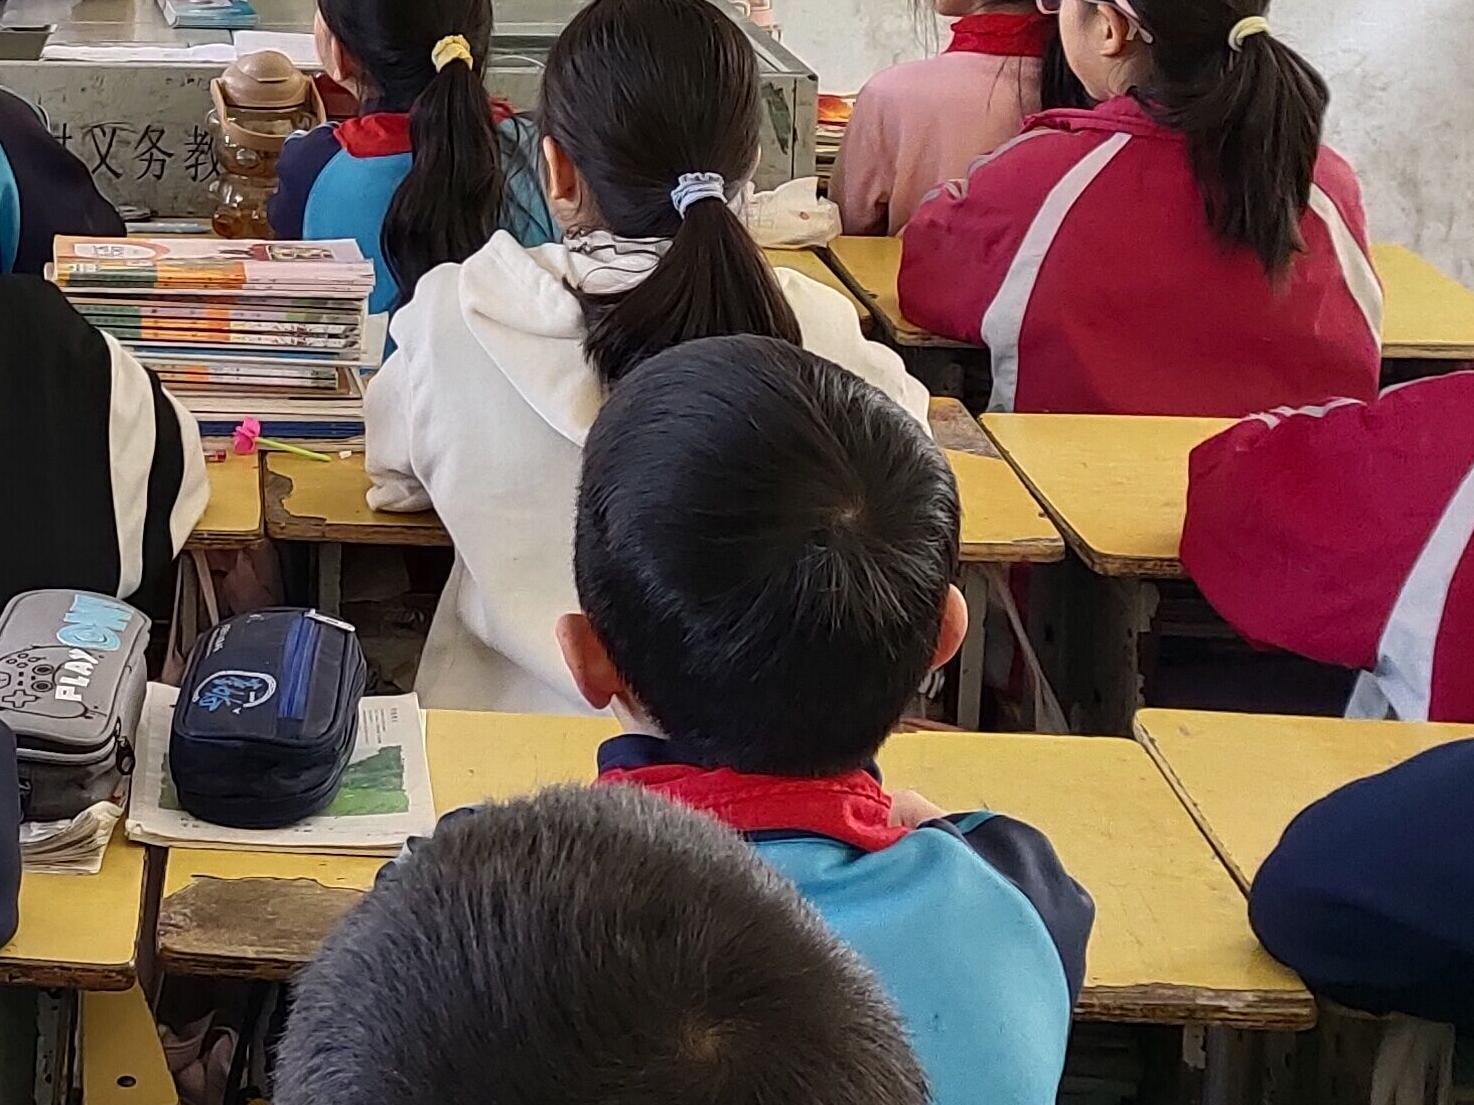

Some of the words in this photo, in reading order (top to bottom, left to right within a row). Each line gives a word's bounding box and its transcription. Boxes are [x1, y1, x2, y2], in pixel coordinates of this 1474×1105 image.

[54, 123, 221, 183] 义务教
[56, 648, 99, 701] PLAY
